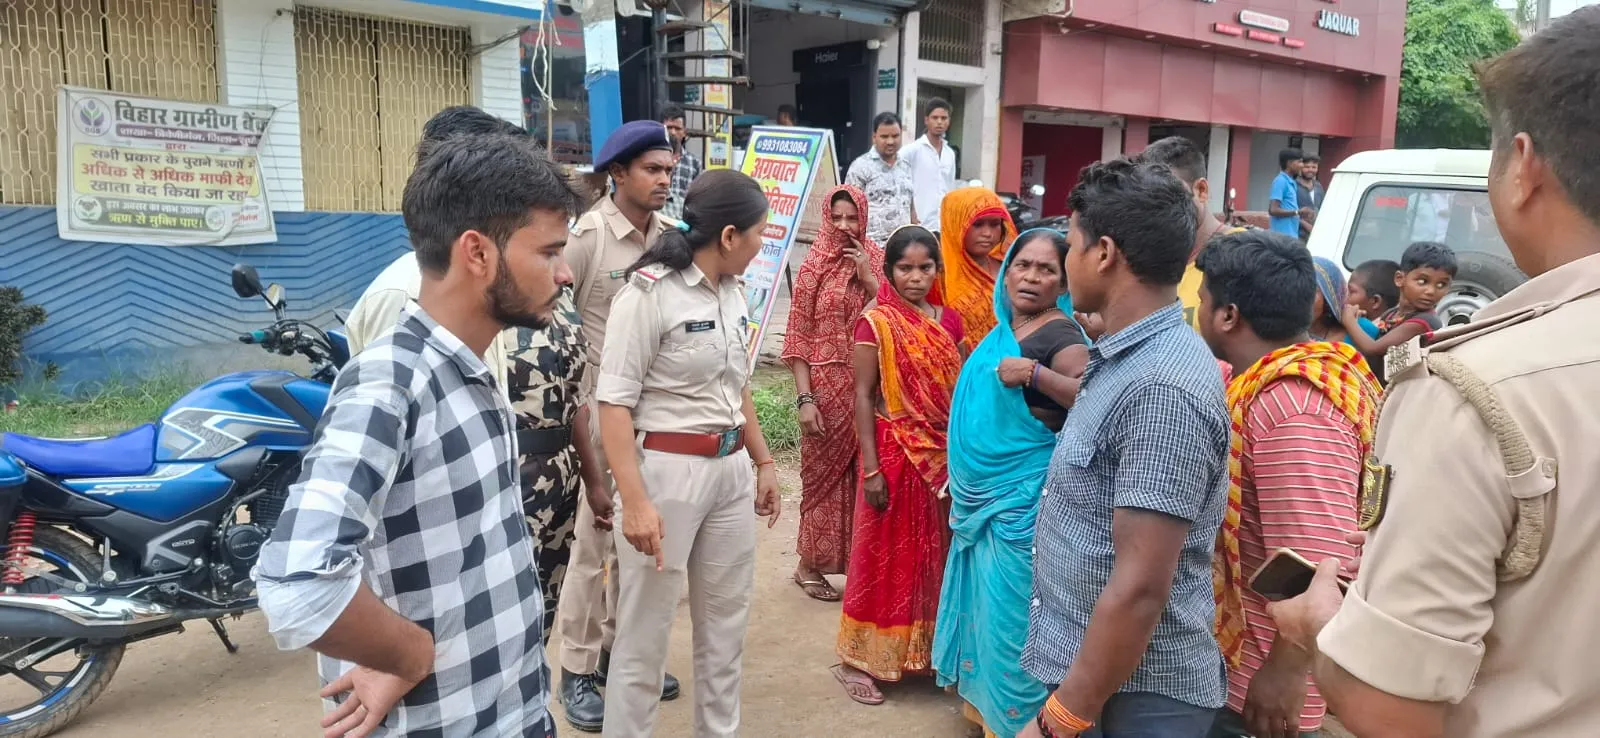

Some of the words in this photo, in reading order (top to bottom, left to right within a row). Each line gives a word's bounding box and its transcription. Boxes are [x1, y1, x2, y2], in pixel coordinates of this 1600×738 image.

[1318, 9, 1360, 36] JAQUAR
[815, 50, 839, 64] Haier
[115, 100, 168, 125] बिहार
[173, 108, 238, 131] ग्रामीण
[90, 148, 119, 160] सभी
[124, 152, 160, 163] प्रकार
[166, 153, 179, 164] के
[182, 156, 212, 169] पुराने
[81, 161, 127, 176] अधिक
[132, 165, 145, 179] से
[150, 167, 194, 182] अधिक
[199, 171, 232, 185] माफी
[751, 158, 800, 182] अग्रवाल
[89, 180, 131, 193] खाता
[135, 182, 158, 196] बंद
[163, 183, 200, 199] किया
[204, 189, 223, 200] जा
[108, 212, 132, 224] ऋण
[135, 211, 146, 225] से
[149, 213, 177, 228] मुक्ति
